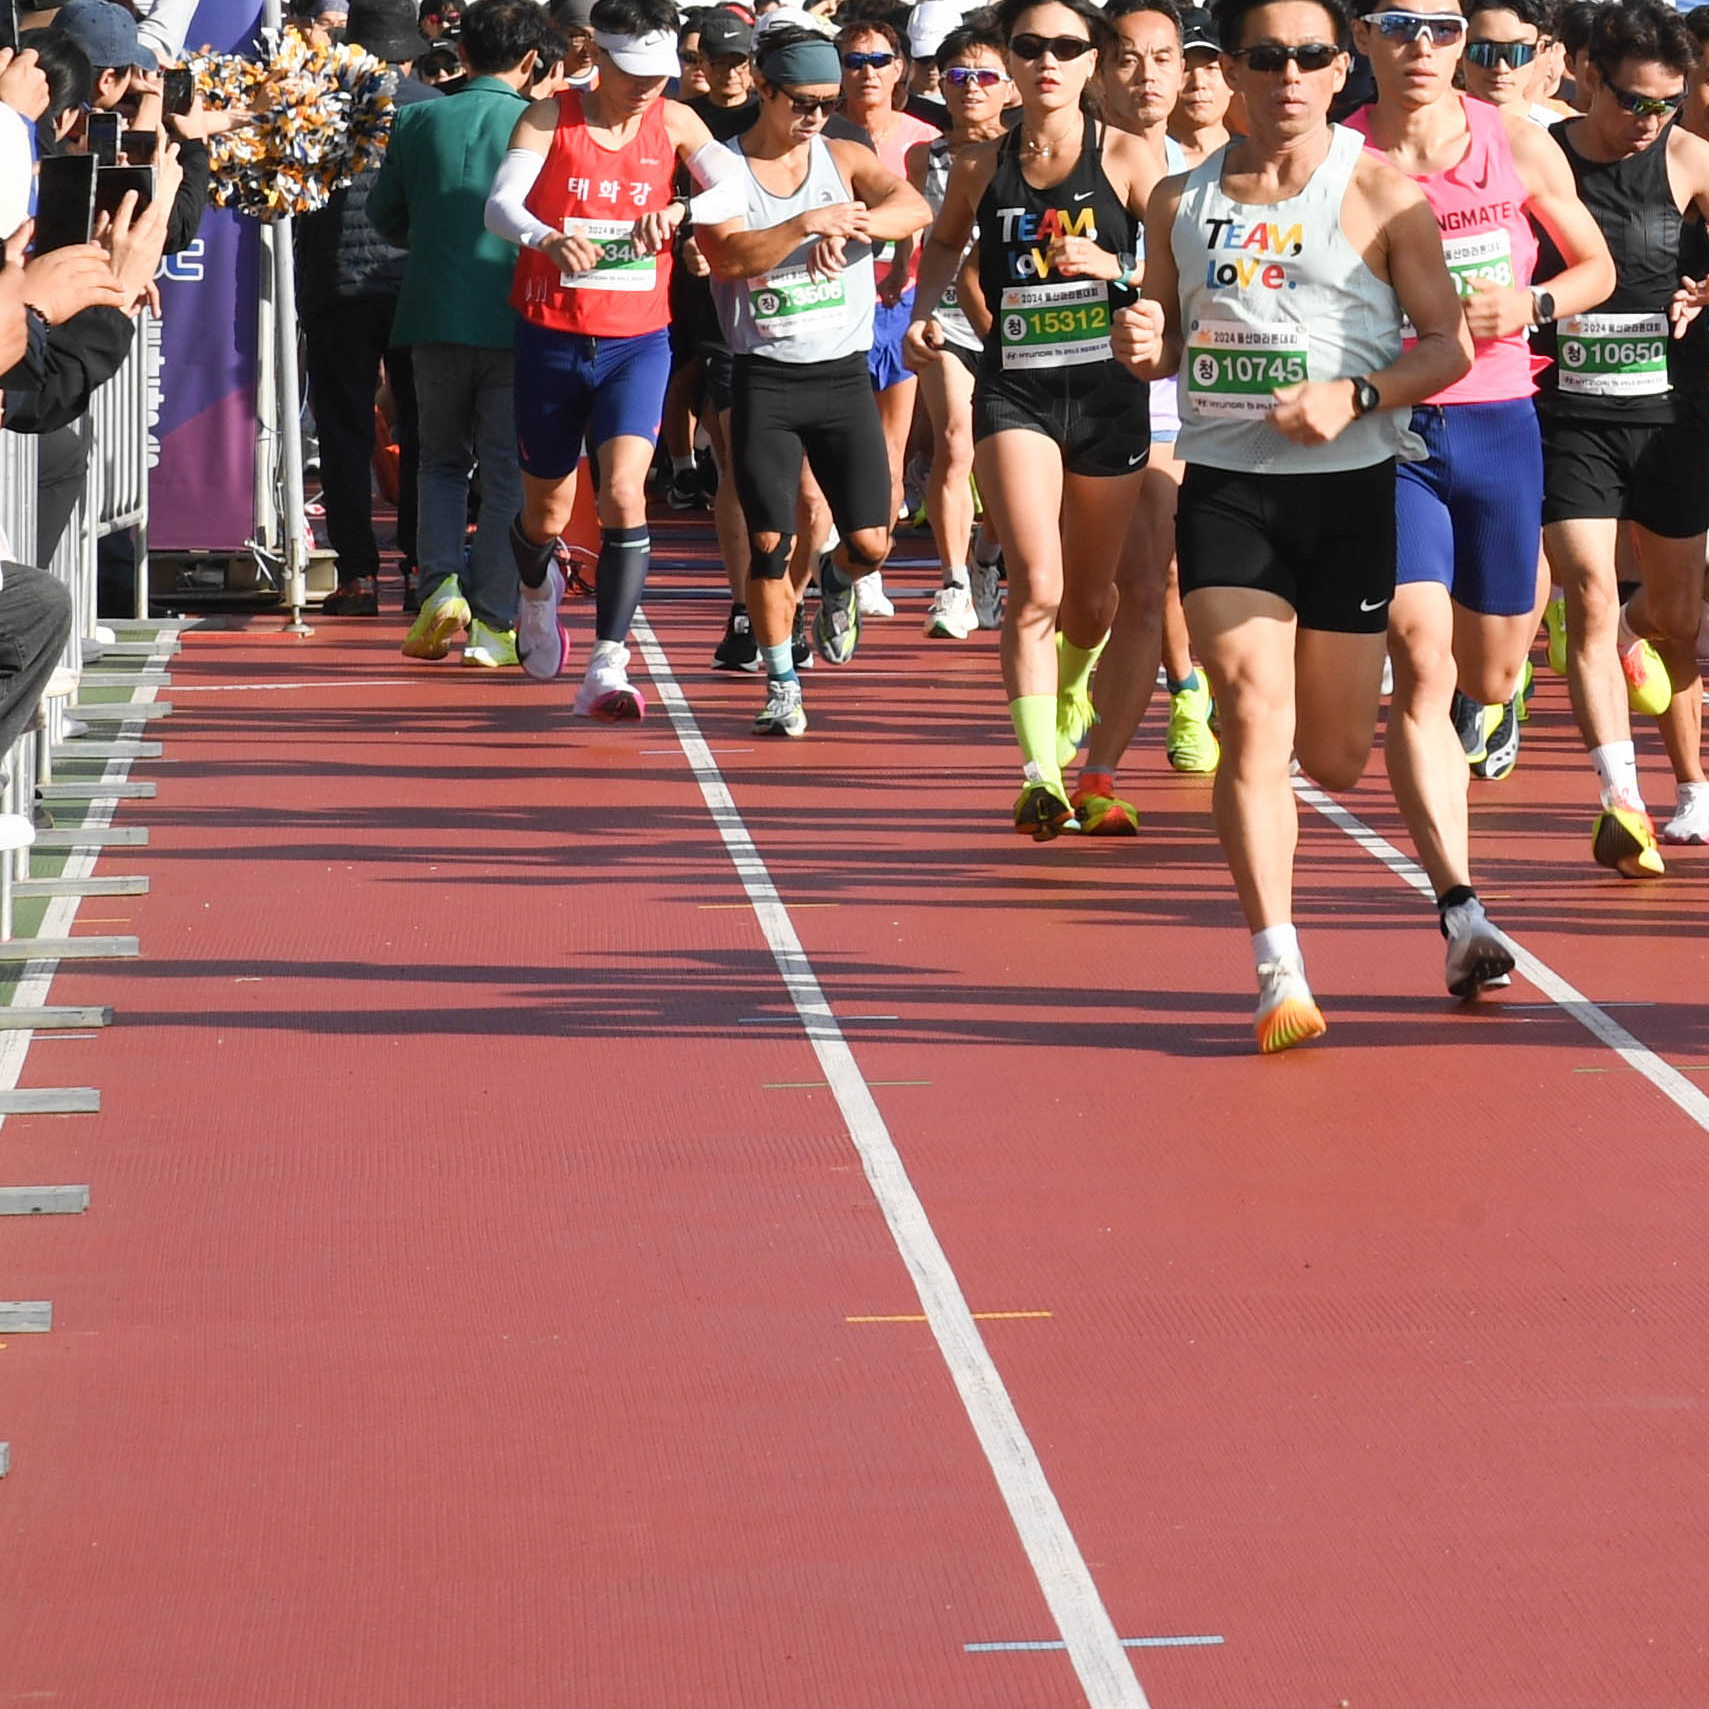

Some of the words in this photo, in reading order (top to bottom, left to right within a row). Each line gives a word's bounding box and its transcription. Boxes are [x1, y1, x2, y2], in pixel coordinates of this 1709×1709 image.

[1021, 291, 1043, 304] 2024
[1030, 306, 1106, 334] 15312
[1214, 331, 1235, 344] 2024
[1591, 342, 1664, 364] 10650
[1223, 356, 1304, 383] 10745
